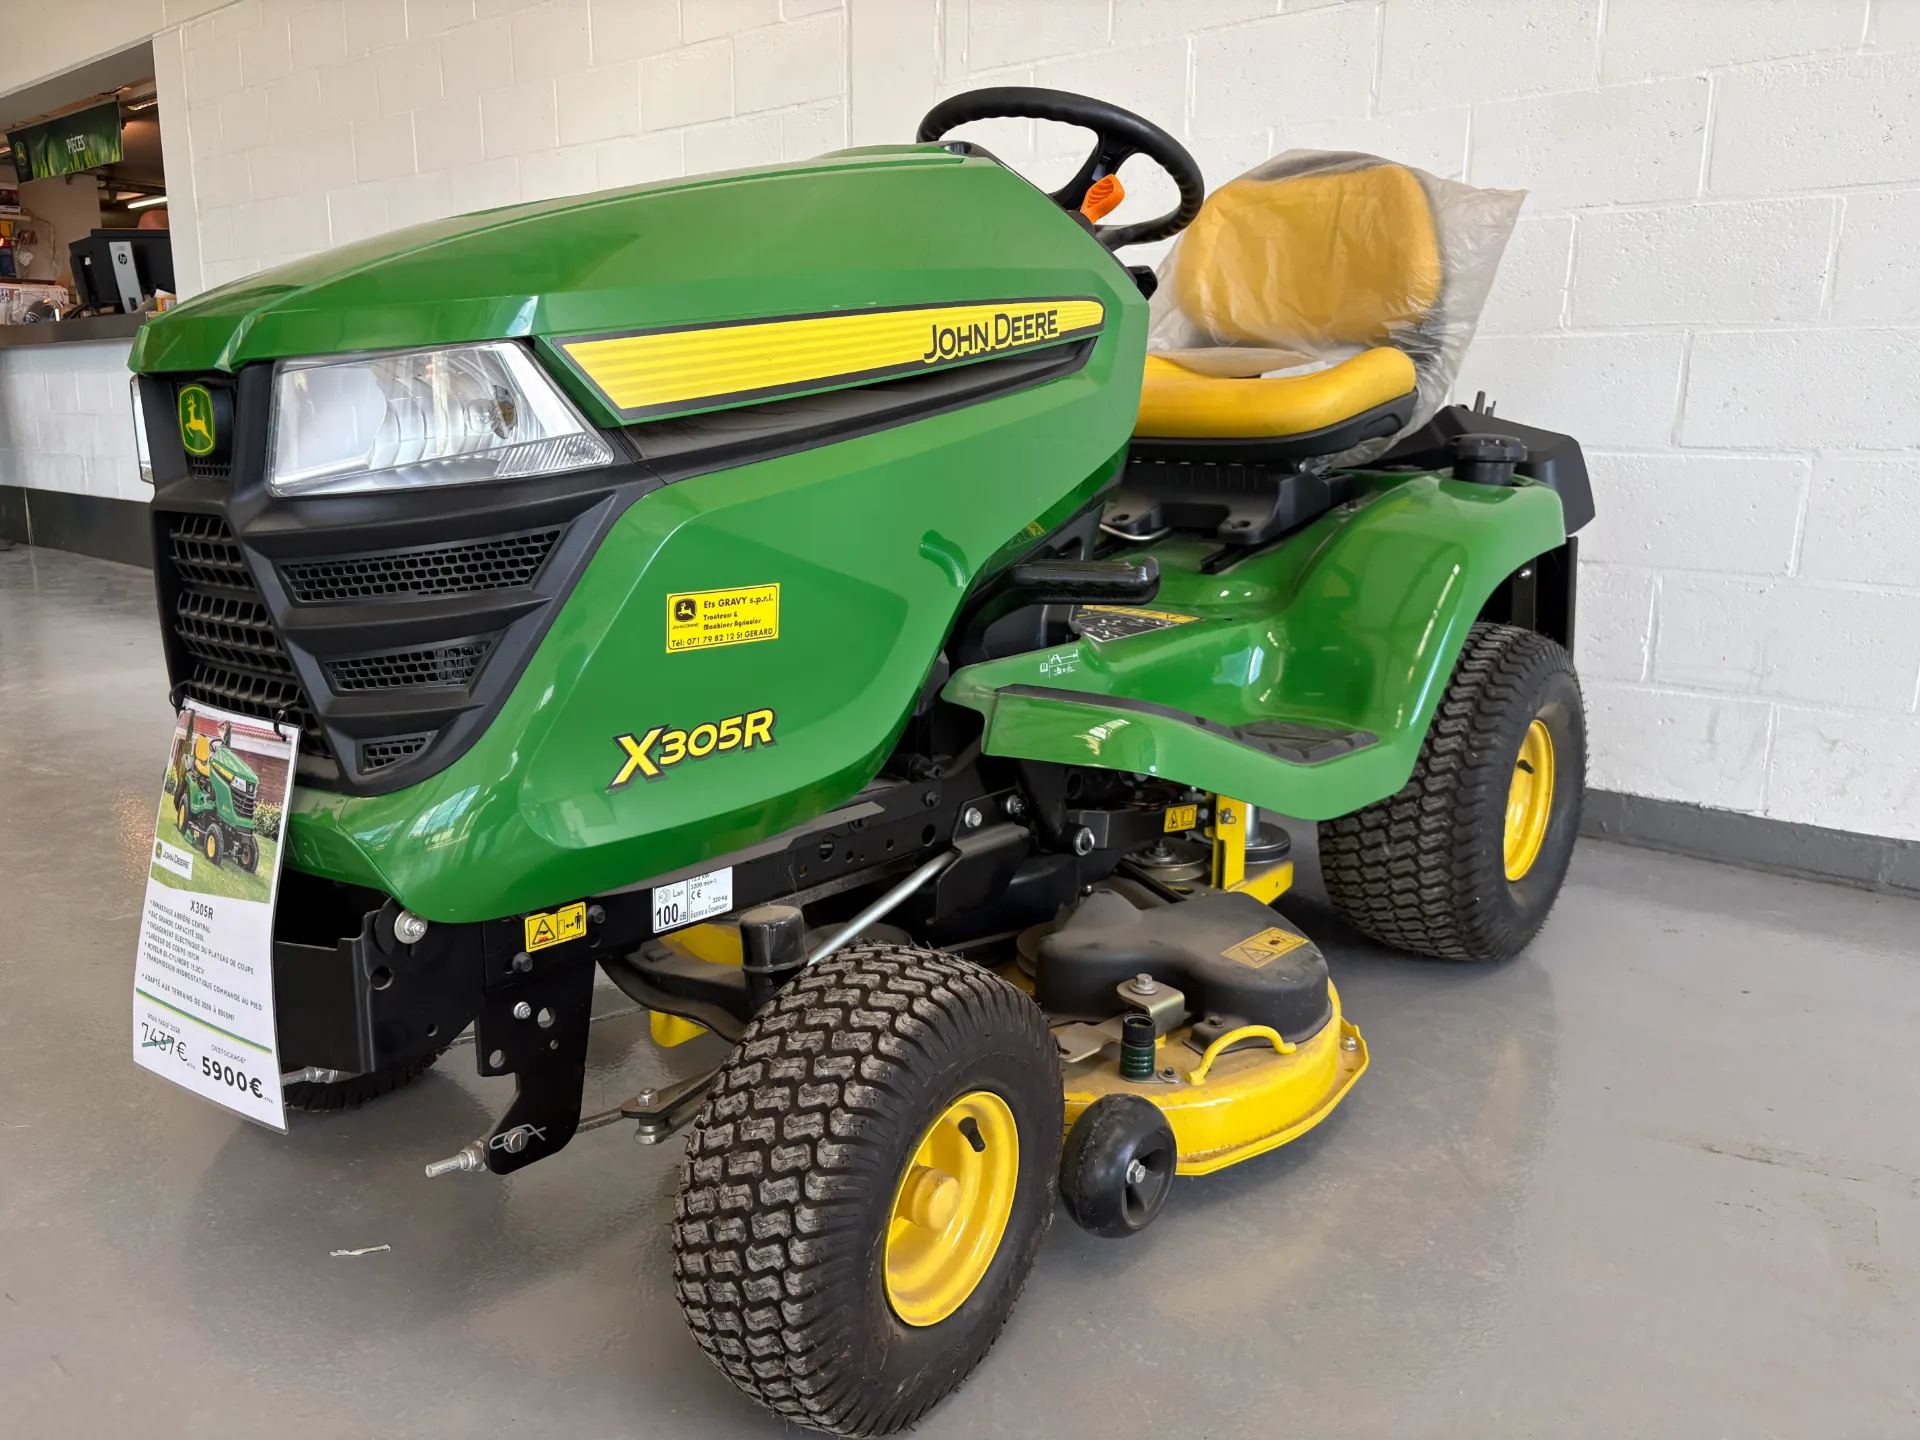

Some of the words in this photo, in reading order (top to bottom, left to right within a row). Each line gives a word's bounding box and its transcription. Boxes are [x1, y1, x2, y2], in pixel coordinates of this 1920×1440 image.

[924, 321, 989, 360] JOHN
[995, 310, 1058, 345] DEERE
[704, 600, 715, 609] Ets
[718, 597, 747, 608] GRAVY
[749, 593, 773, 605] s.p.r.l.
[687, 637, 700, 646] 071
[703, 635, 712, 643] 79
[715, 634, 724, 642] 82
[744, 628, 773, 638] GERARD
[606, 707, 777, 791] X305R
[190, 900, 213, 920] X305R
[656, 903, 678, 927] 100
[208, 949, 228, 963] PLATEAU
[230, 959, 236, 967] DE
[213, 985, 241, 1002] COMMANDE
[250, 1000, 263, 1011] PIED
[202, 1056, 263, 1098] 5900€
